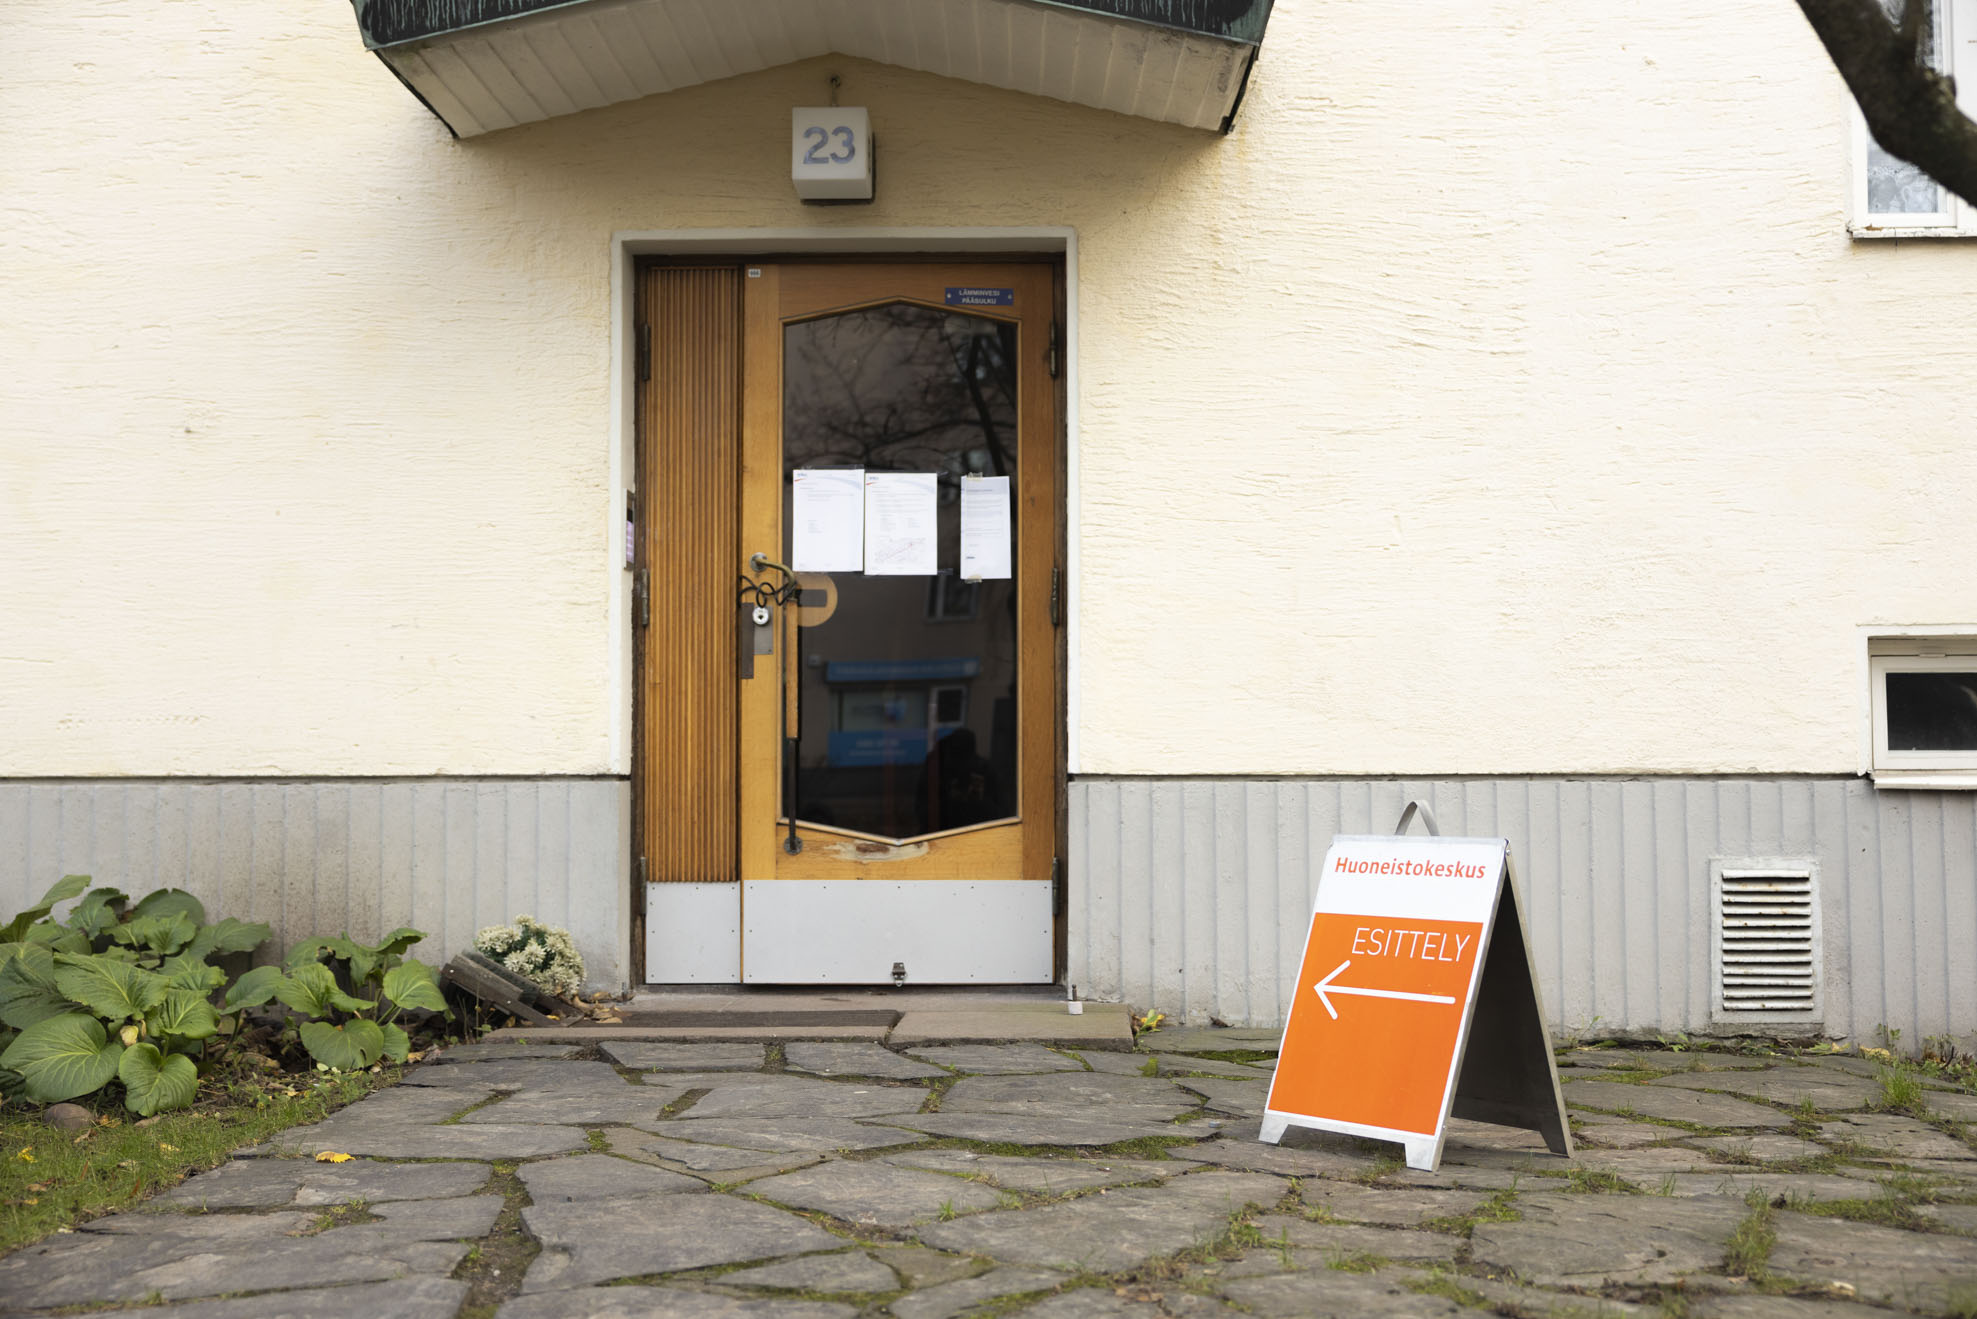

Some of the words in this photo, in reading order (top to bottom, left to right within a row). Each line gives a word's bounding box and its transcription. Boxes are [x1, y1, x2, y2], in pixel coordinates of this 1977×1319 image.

[803, 126, 856, 165] 23
[1335, 857, 1486, 878] Huoneistokeskus
[1351, 927, 1471, 962] ESITTELY
